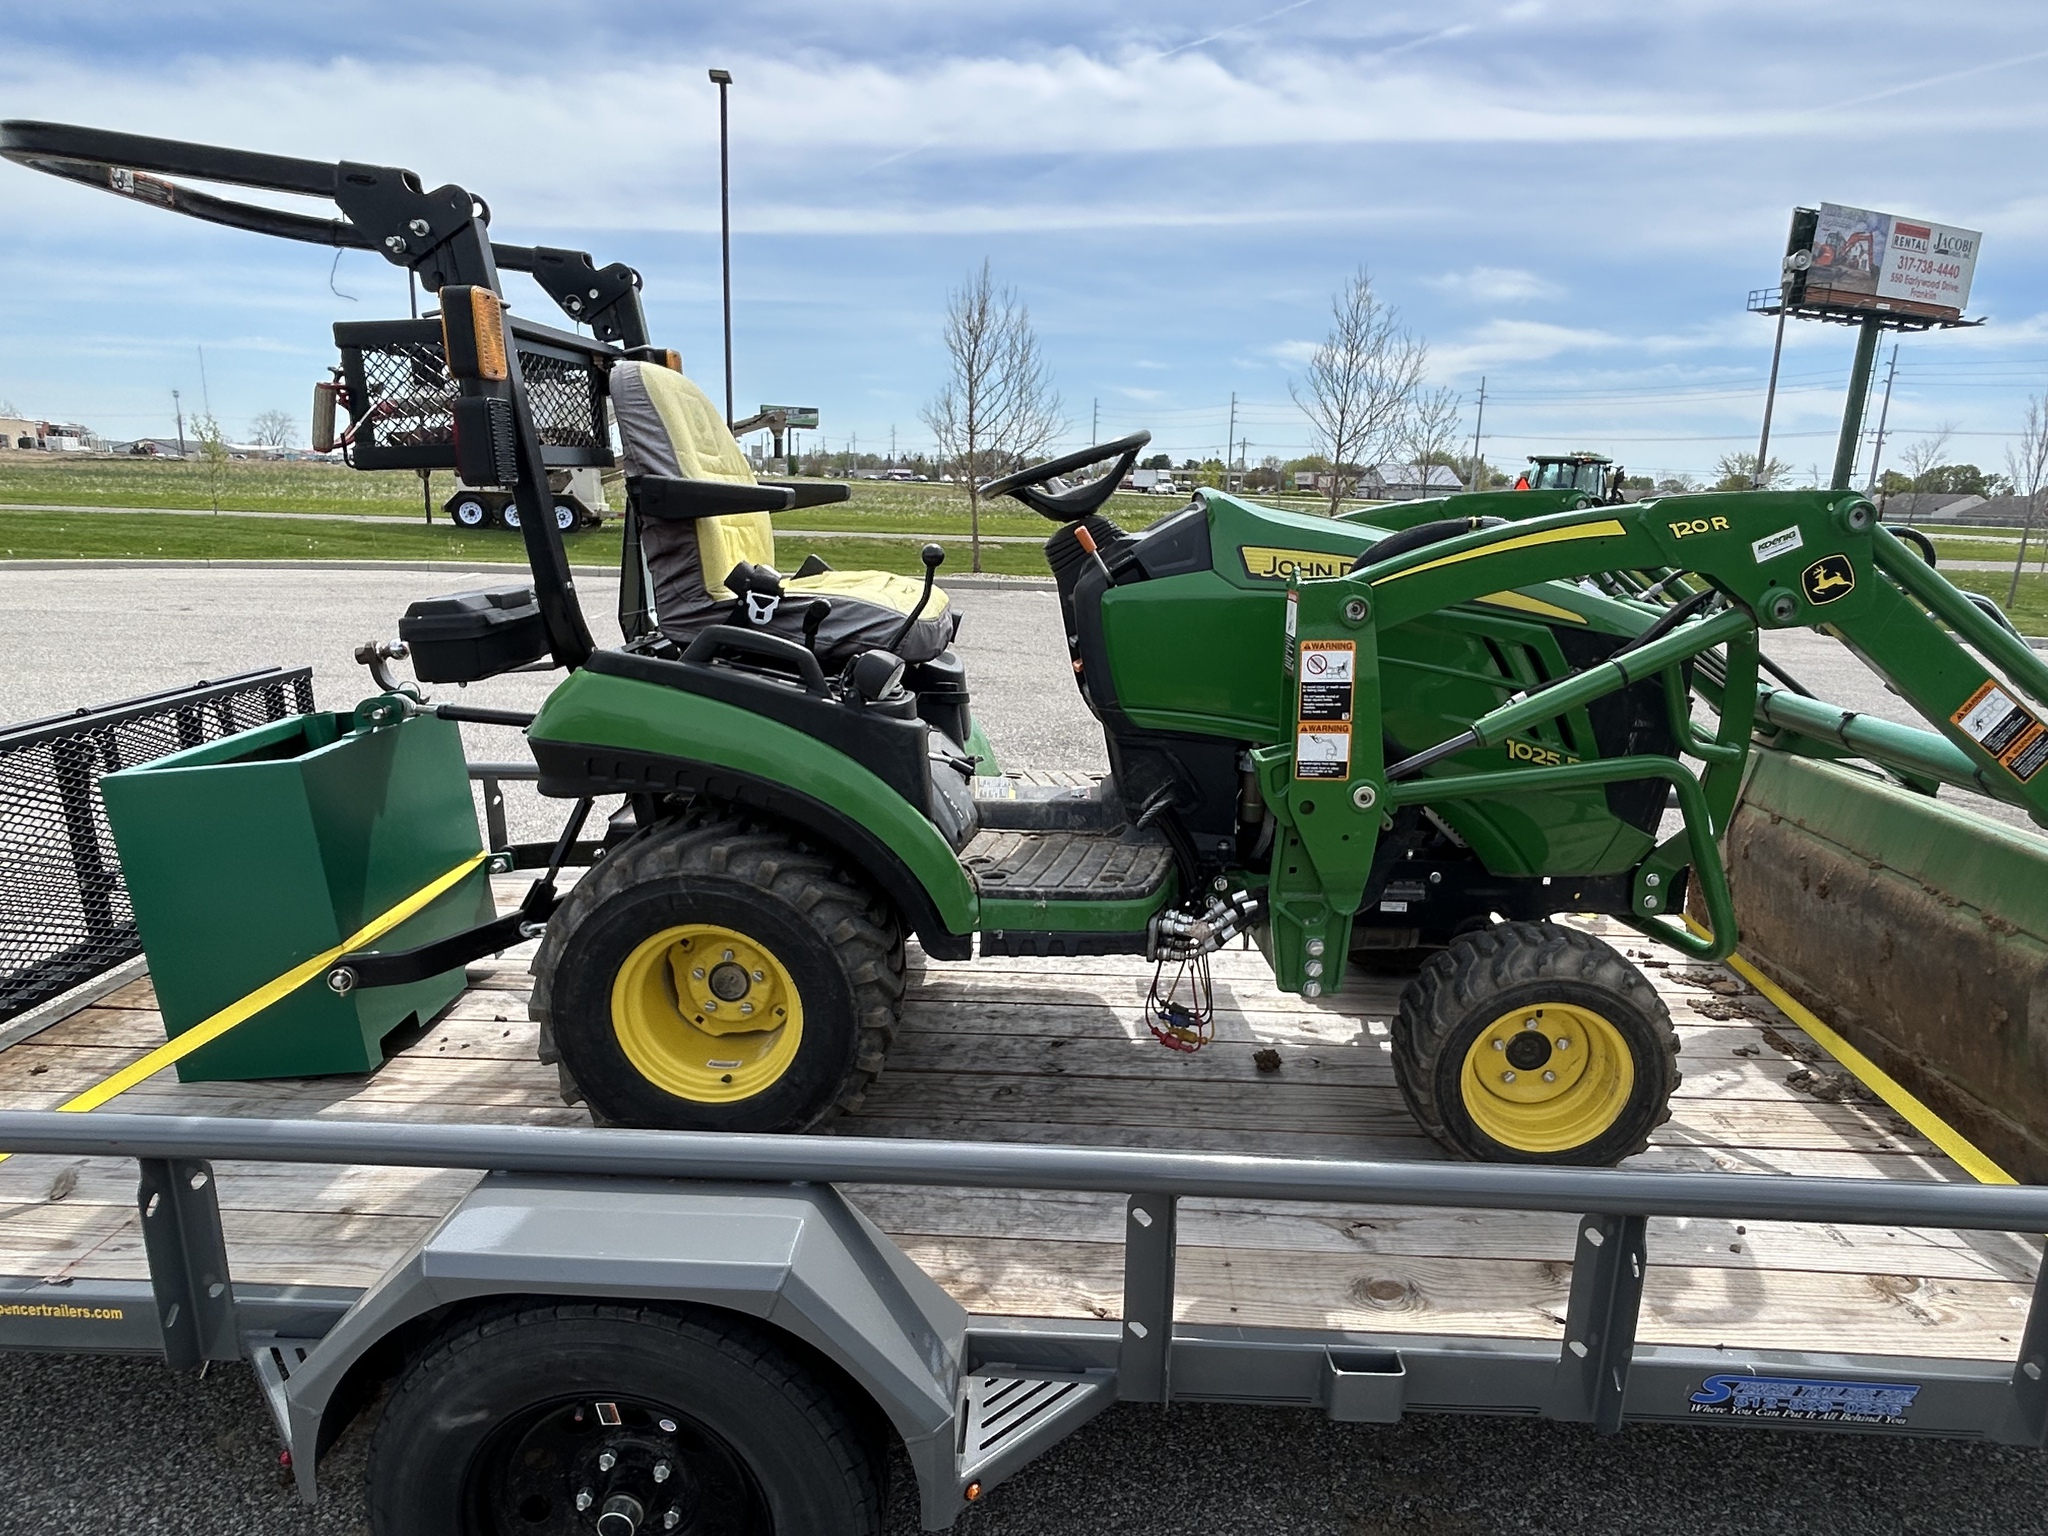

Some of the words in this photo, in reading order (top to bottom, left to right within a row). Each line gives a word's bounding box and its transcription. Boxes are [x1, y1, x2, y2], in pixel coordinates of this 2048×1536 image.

[1894, 235, 1926, 251] RENTAL
[1933, 232, 1974, 252] JACOBI
[1897, 255, 1960, 279] 317-738-4440
[1904, 273, 1941, 289] Earlywood
[1668, 519, 1709, 539] 120
[1710, 516, 1730, 530] R
[1263, 556, 1333, 577] JOHN
[1311, 642, 1353, 650] WARNING
[1964, 685, 1991, 712] WARNING
[1308, 724, 1349, 733] WARNING
[2012, 728, 2039, 755] WARNING
[1506, 739, 1561, 766] 1025
[1690, 1404, 1727, 1414] Where
[1731, 1406, 1752, 1416] You
[1755, 1408, 1780, 1417] Can
[1782, 1410, 1803, 1419] Put
[1806, 1411, 1817, 1419] It
[1818, 1412, 1839, 1421] All
[1840, 1413, 1882, 1424] Behind
[1885, 1416, 1907, 1425] You
